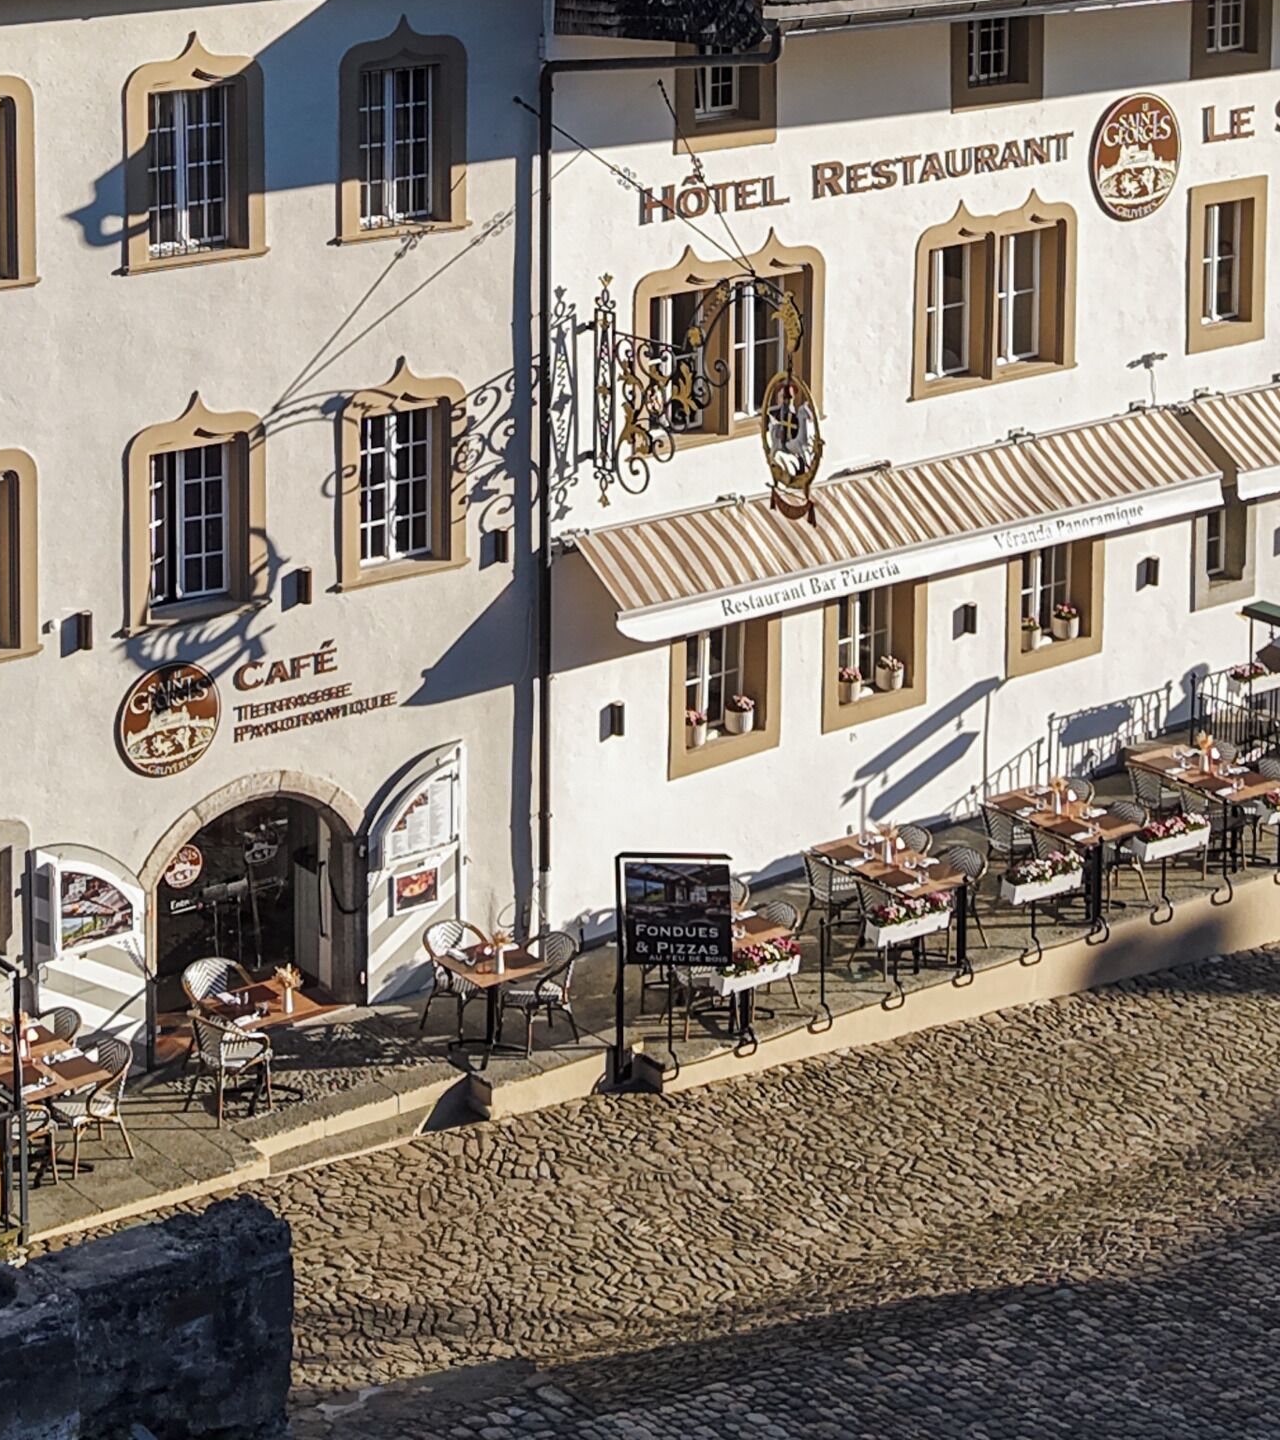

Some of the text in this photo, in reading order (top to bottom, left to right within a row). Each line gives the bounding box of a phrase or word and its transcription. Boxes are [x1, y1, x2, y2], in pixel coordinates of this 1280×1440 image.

[1202, 104, 1255, 144] LE
[639, 131, 1074, 226] HÔTEL RESTAURANT
[993, 503, 1144, 549] Véranda Panoramique
[720, 560, 901, 617] Restaurant Bar Pizzeria
[233, 638, 338, 692] CAFÉ
[233, 682, 352, 722] TERRASSE
[233, 691, 398, 744] PANORAMIQUE
[635, 924, 719, 939] FONDUES
[635, 941, 719, 956] & PIZZAS
